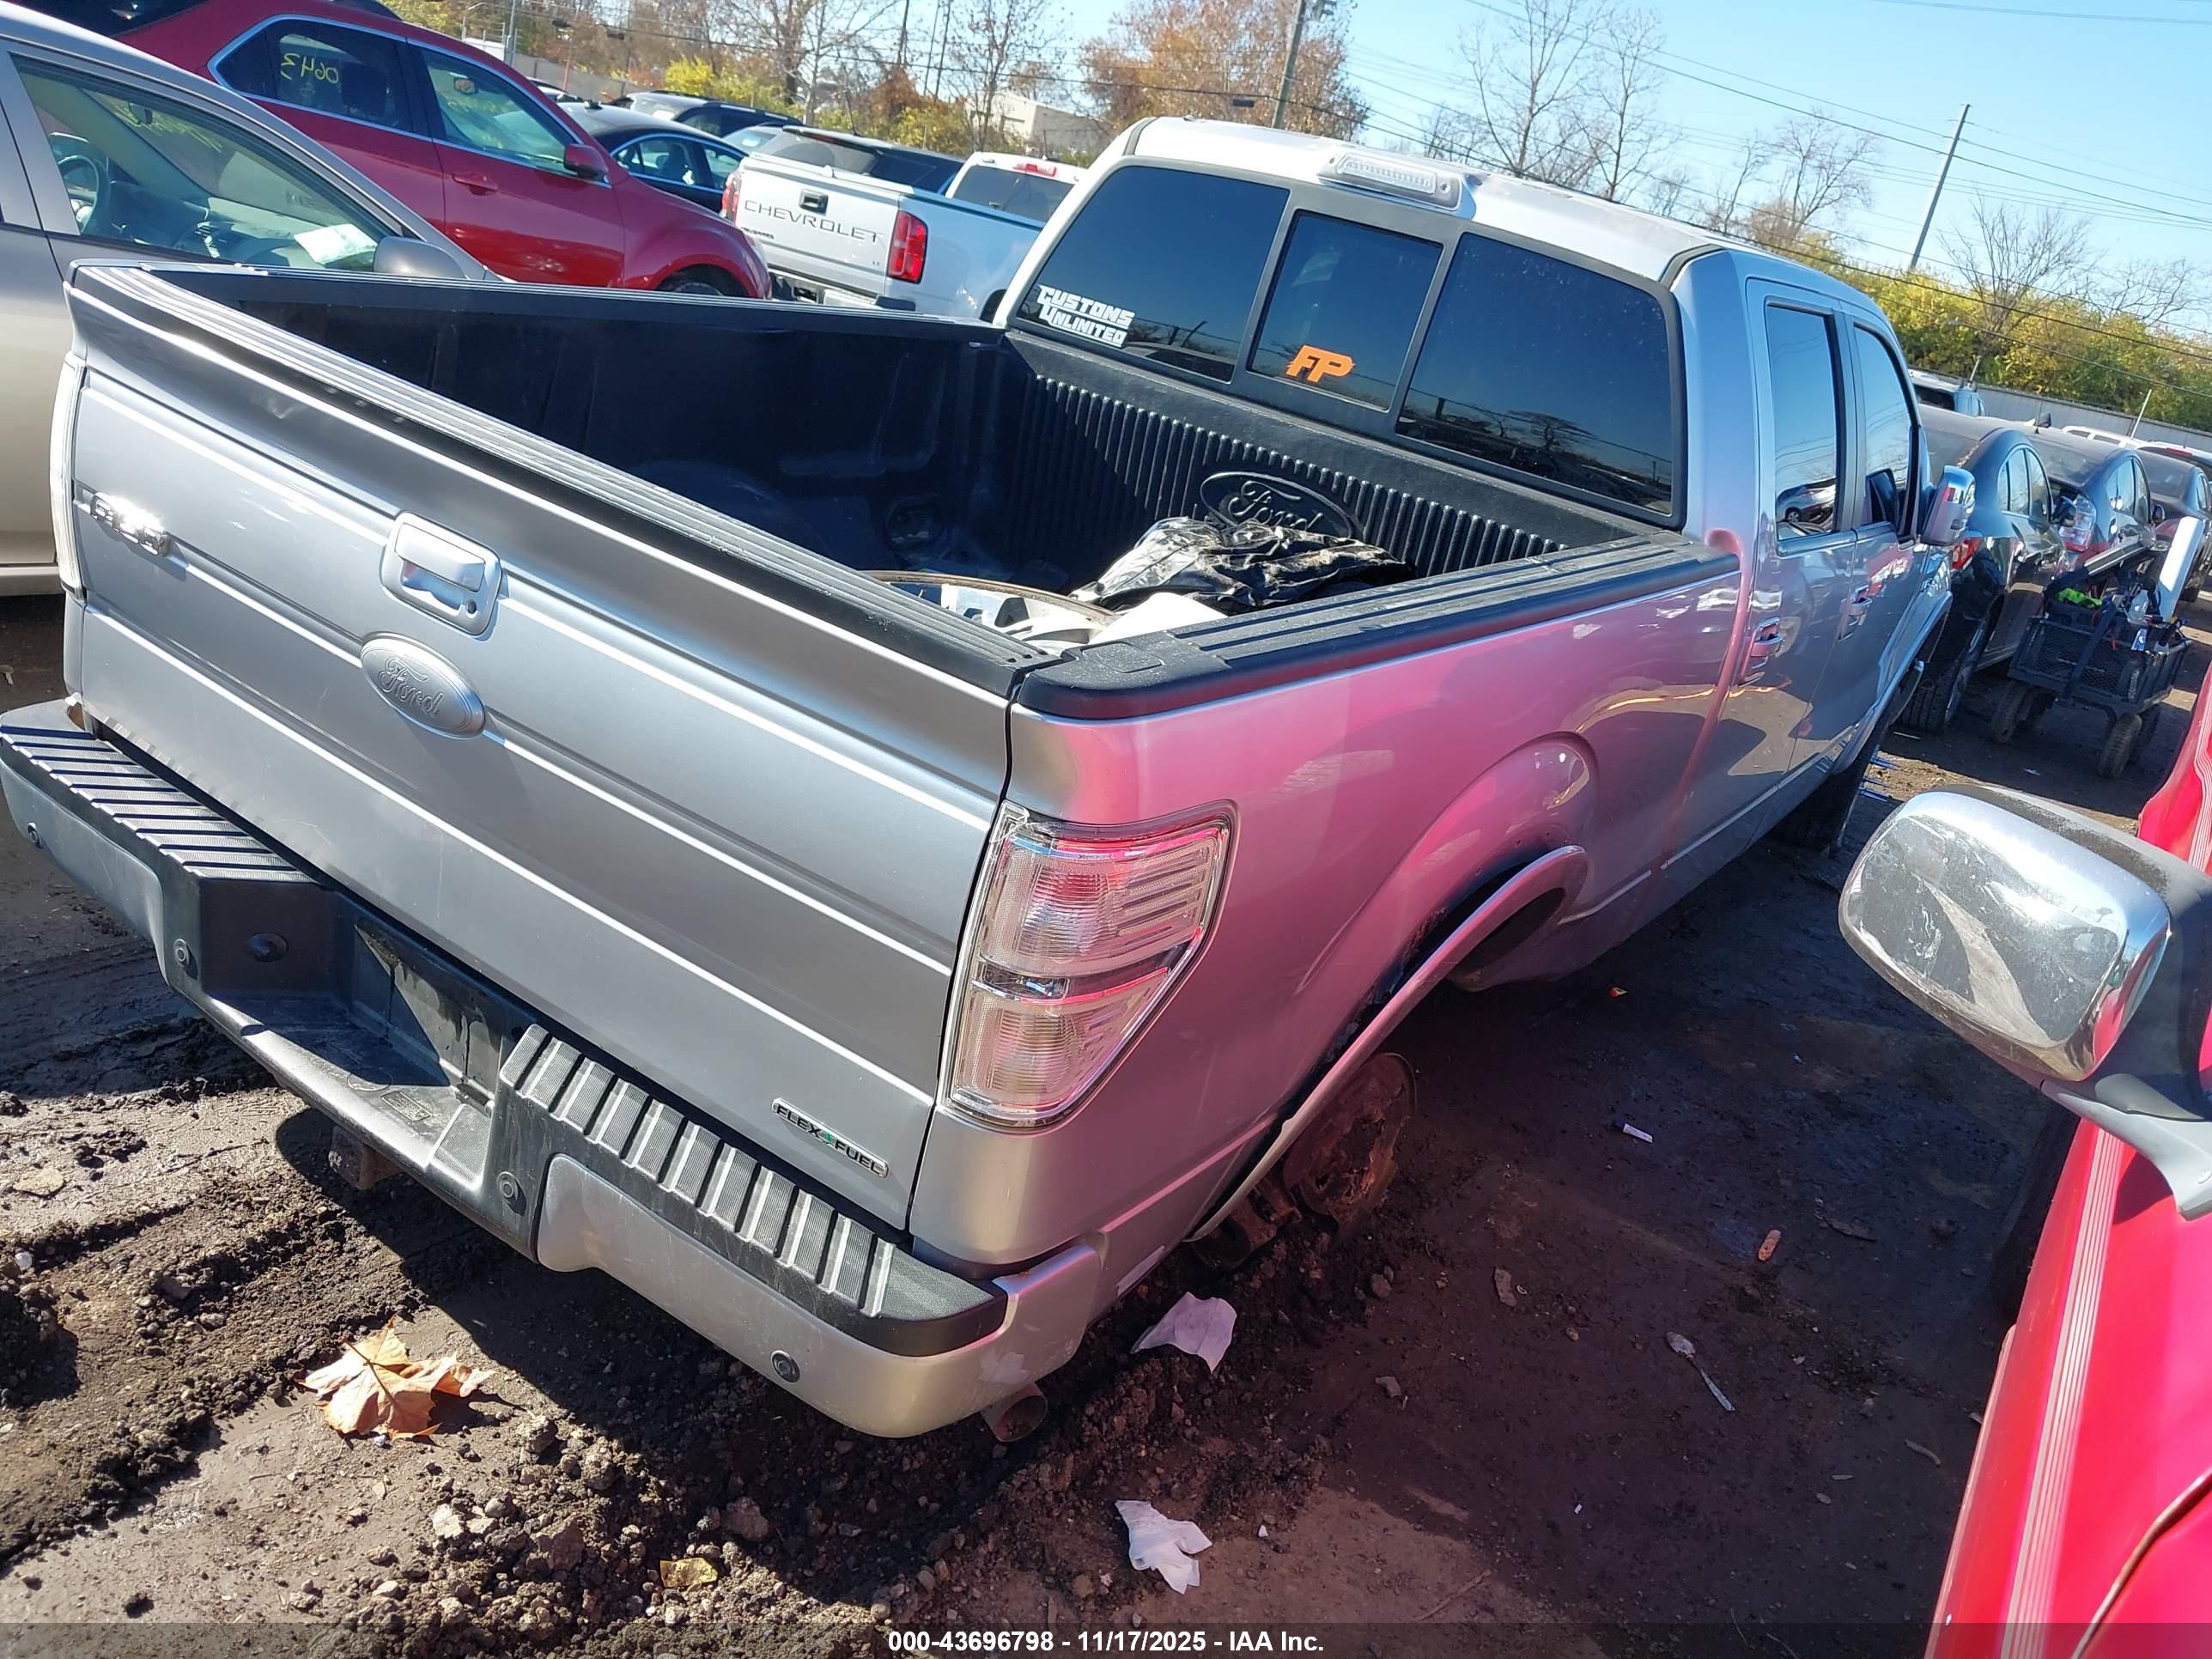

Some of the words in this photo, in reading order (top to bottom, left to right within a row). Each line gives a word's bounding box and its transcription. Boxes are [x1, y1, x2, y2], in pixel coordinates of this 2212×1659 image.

[744, 200, 883, 242] CHEVROLET
[1037, 284, 1135, 326] CUSTOMS
[1039, 304, 1127, 345] UNLIMITED
[1228, 481, 1323, 531] Ford
[378, 657, 444, 718] Ford
[776, 1104, 822, 1139] FLEX
[834, 1139, 885, 1175] FUEL
